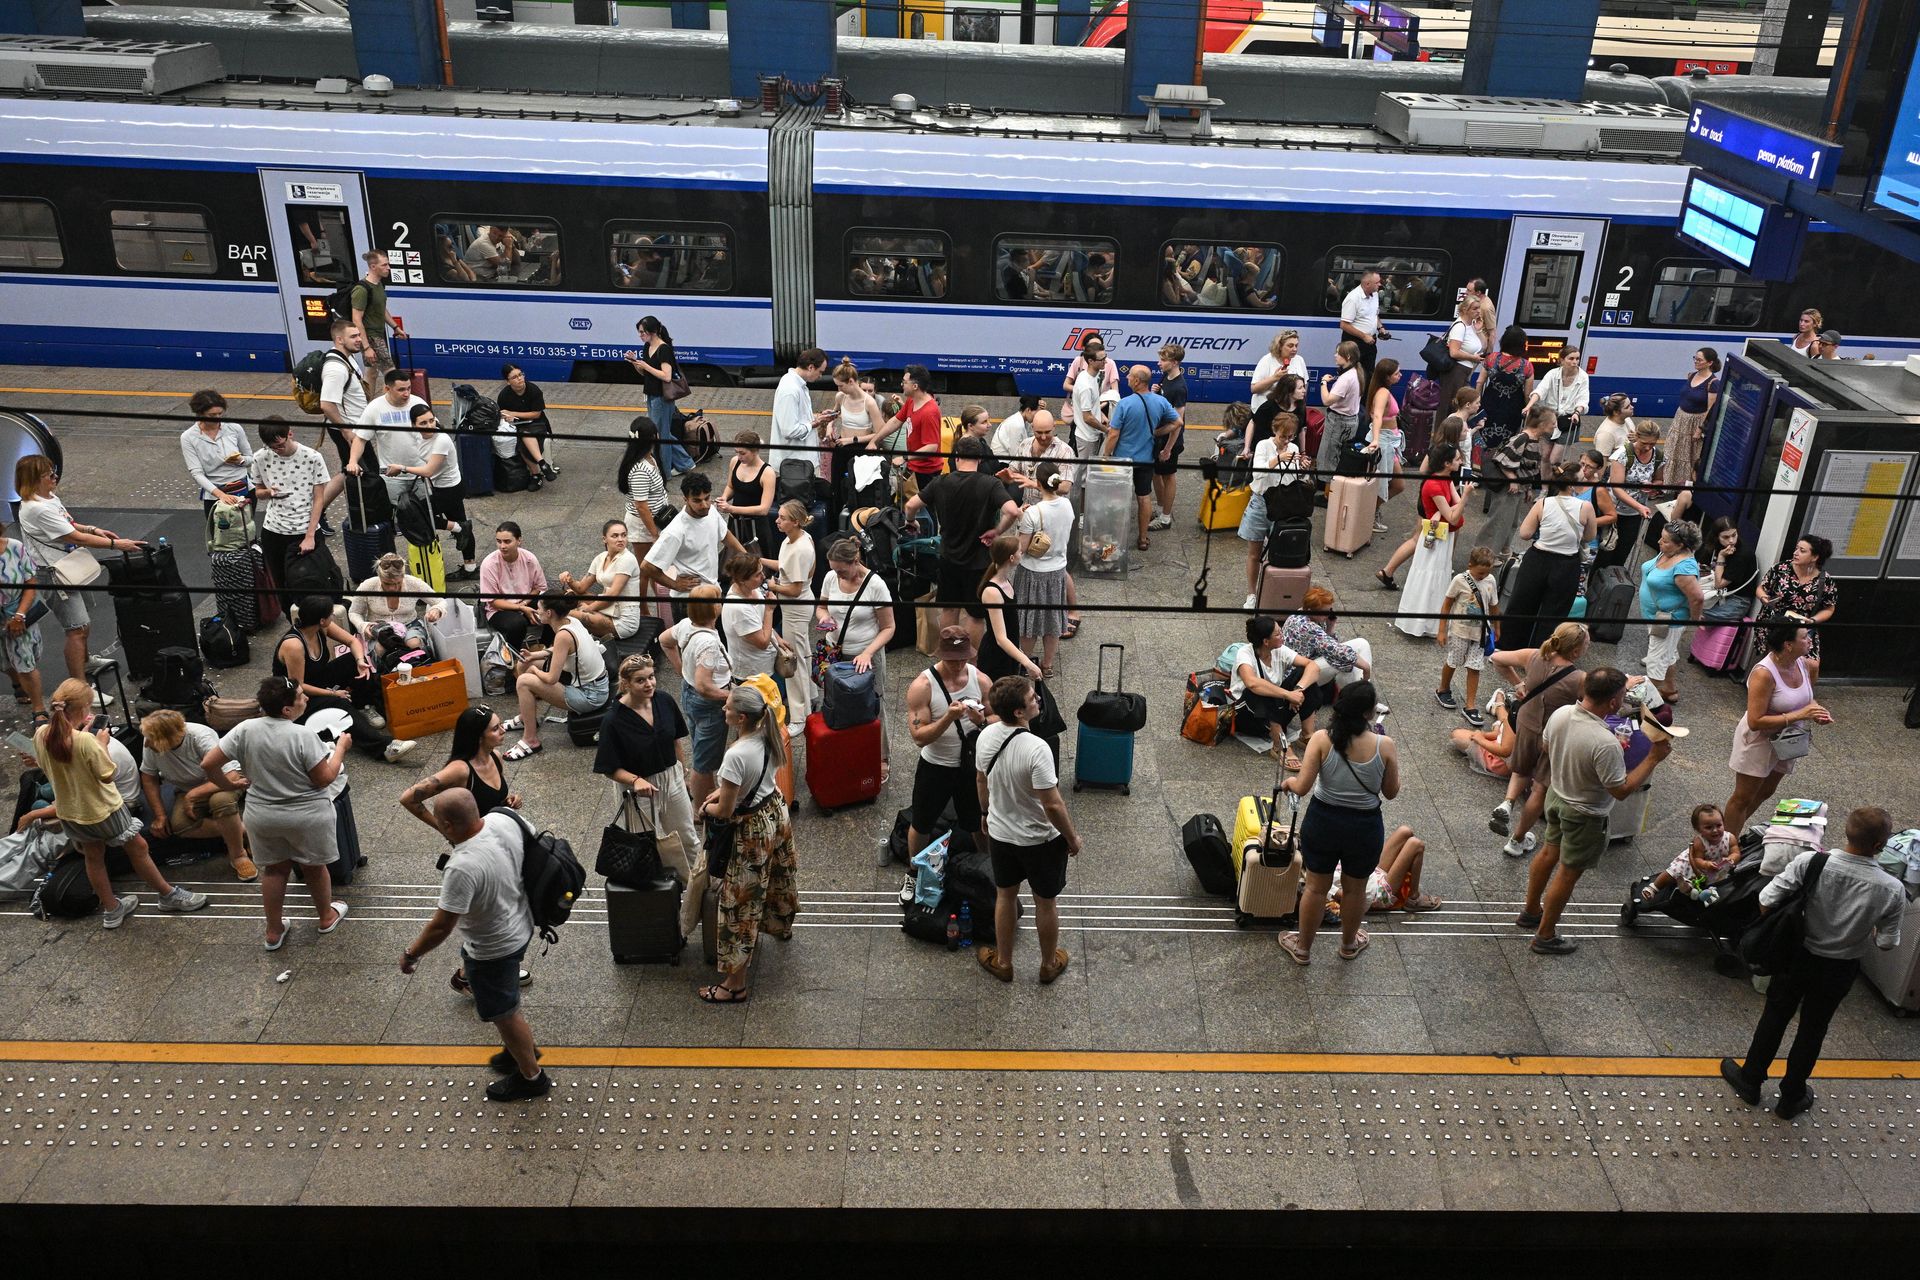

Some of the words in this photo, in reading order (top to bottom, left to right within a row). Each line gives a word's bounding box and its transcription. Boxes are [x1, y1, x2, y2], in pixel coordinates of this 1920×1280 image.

[850, 15, 856, 23] 2
[1689, 108, 1702, 133] 5
[1700, 126, 1710, 137] tor
[1709, 128, 1724, 143] track
[1756, 149, 1776, 165] peron
[1776, 155, 1805, 175] platform
[1808, 151, 1821, 180] 1
[1906, 151, 1920, 166] ALL
[392, 221, 411, 248] 2
[228, 244, 267, 261] BAR
[1615, 265, 1634, 291] 2
[572, 320, 590, 328] PKP
[1125, 334, 1161, 348] PKP
[1161, 336, 1250, 351] INTERCITY
[434, 343, 485, 354] PL-PKPIC
[487, 345, 500, 354] 94
[502, 345, 514, 355] 51
[517, 346, 525, 355] 2
[527, 346, 545, 356] 150
[547, 347, 577, 357] 335-9
[591, 348, 644, 359] ED16116
[1010, 358, 1044, 366] Klimatyzacja
[406, 707, 426, 716] LOUIS
[427, 700, 455, 711] VUITTON
